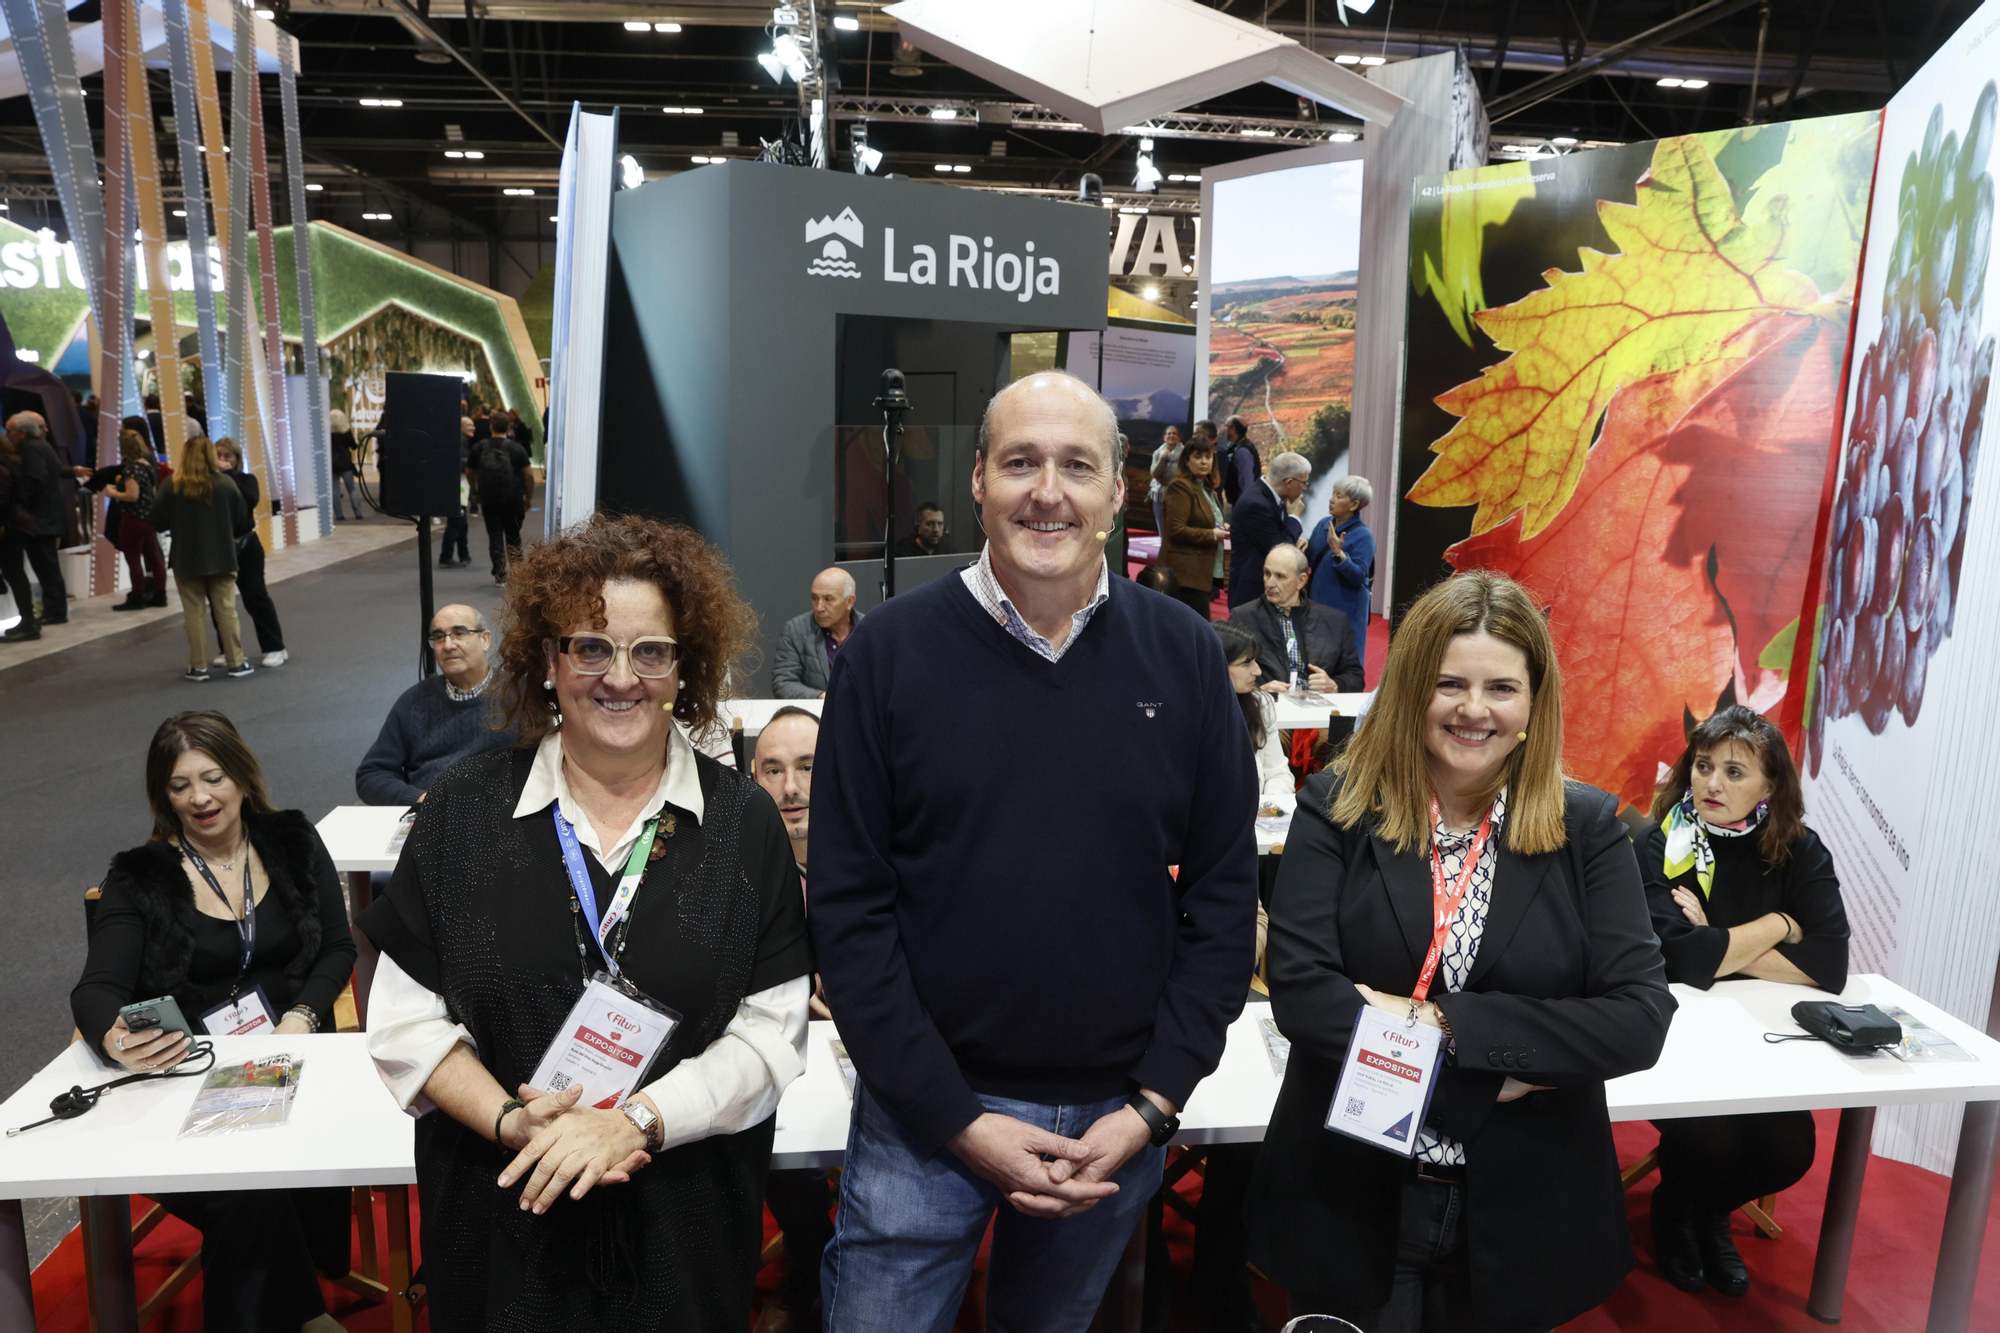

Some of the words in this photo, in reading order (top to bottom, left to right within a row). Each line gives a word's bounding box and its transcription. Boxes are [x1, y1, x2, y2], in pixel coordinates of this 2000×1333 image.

[1421, 186, 1432, 196] 42
[1437, 186, 1444, 195] La
[1446, 183, 1465, 195] Rioja,
[1466, 178, 1506, 191] Naturaleza
[1507, 176, 1525, 186] Gran
[1526, 172, 1556, 184] Reserva
[884, 227, 937, 285] La
[949, 234, 1060, 303] Rioja
[1868, 799, 1889, 840] nombre
[1888, 825, 1896, 851] de
[1896, 838, 1910, 872] vino
[576, 870, 592, 906] @visitbrasil
[1453, 864, 1472, 897] ifema.es
[583, 1032, 634, 1062] EXPOSITOR
[1366, 1054, 1420, 1080] EXPOSITOR
